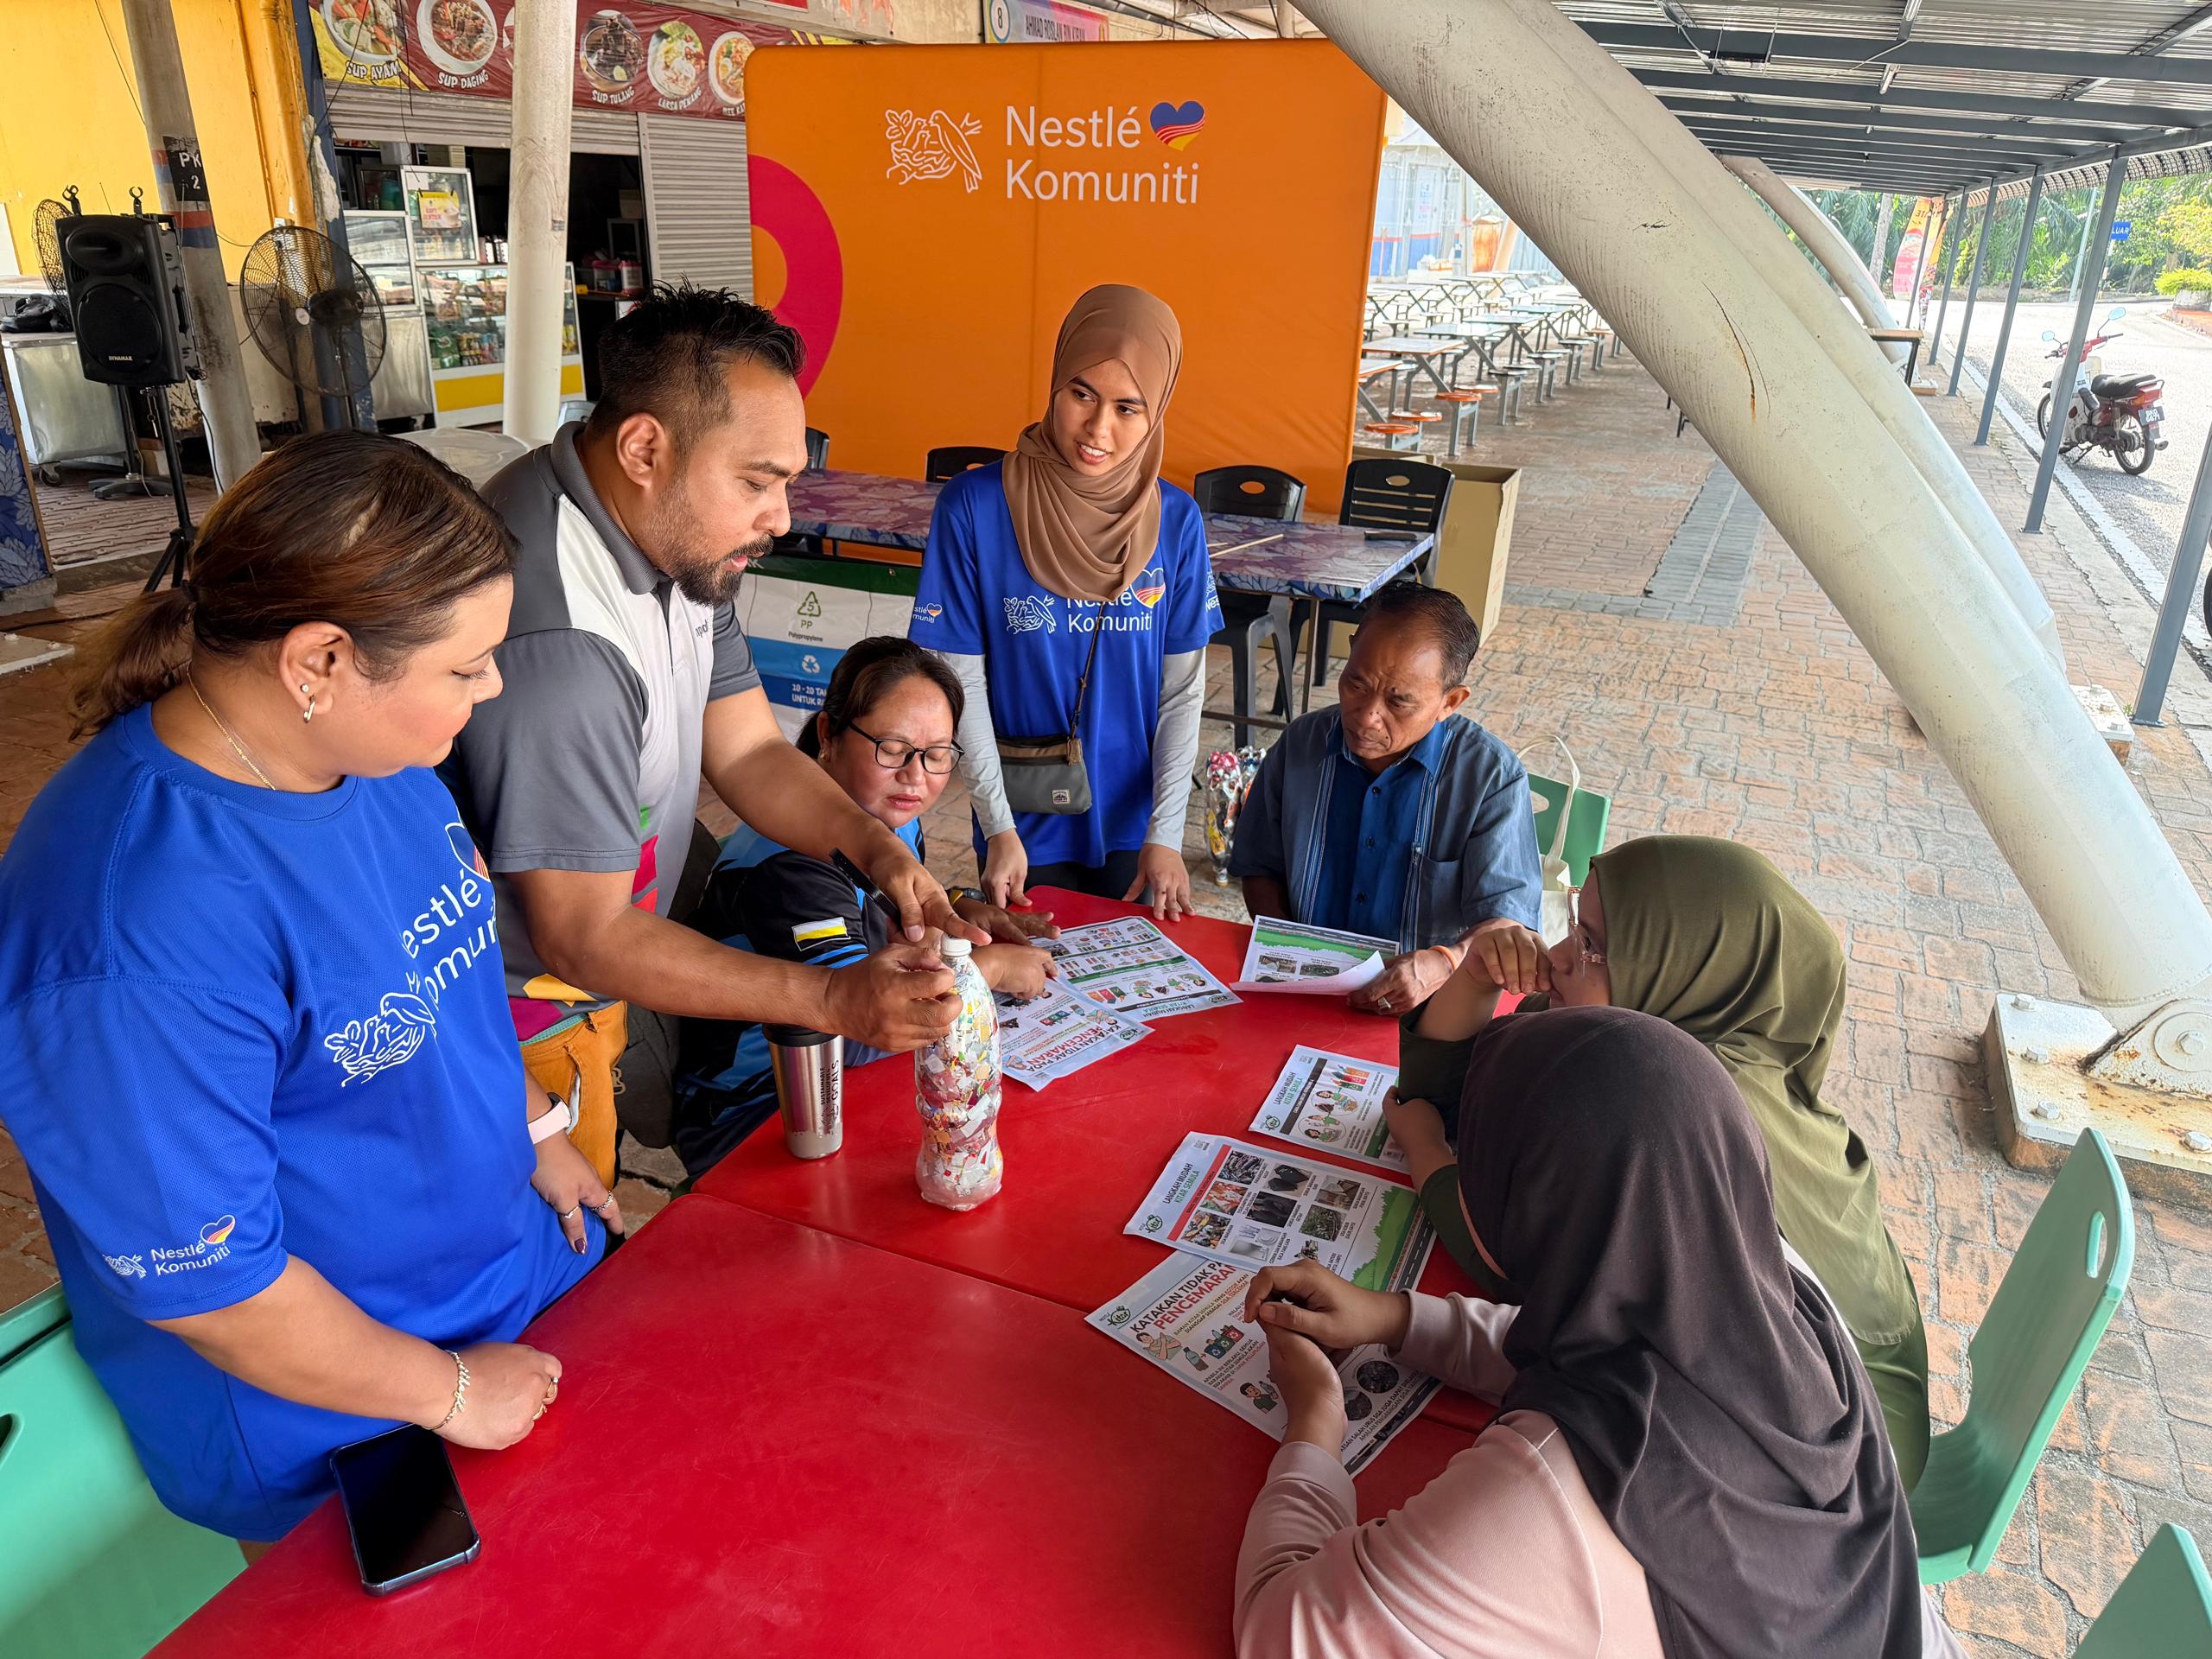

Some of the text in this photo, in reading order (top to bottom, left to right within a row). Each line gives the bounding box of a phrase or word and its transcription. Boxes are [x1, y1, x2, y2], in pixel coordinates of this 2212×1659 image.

[997, 7, 1002, 29] 8
[1026, 14, 1043, 37] AHMAD
[346, 59, 401, 81] SUP AYAM
[437, 69, 490, 89] SUP DAGING
[592, 86, 636, 105] SUP TULANG
[658, 98, 678, 111] LAKSA
[1006, 104, 1141, 149] Nestlé
[179, 152, 202, 168] PK
[191, 175, 201, 189] 2
[1006, 158, 1200, 205] Komuniti
[806, 601, 815, 612] 5
[800, 619, 813, 630] PP
[912, 613, 935, 624] muniti
[1068, 611, 1153, 632] Komuniti
[788, 630, 823, 643] Polypropylene
[791, 694, 817, 706] UNTUK
[401, 868, 481, 958] estlé
[1028, 1025, 1099, 1064] PENCEMARAN
[1079, 1025, 1120, 1048] KATAKAN
[1053, 1046, 1079, 1059] TIDAK
[1027, 1058, 1053, 1072] PADA
[1162, 1163, 1192, 1204] LANGKAH MUDAH
[1174, 1170, 1199, 1203] KITAR SEMULA
[150, 1239, 206, 1262] Nestlé
[155, 1243, 231, 1277] Komuniti
[1131, 1291, 1182, 1332] KATAKAN
[1179, 1268, 1210, 1293] TIDAK
[1188, 1313, 1198, 1323] KITAR
[1214, 1293, 1225, 1302] YANG
[1236, 1274, 1248, 1283] AKAN
[1351, 1425, 1365, 1440] SALAH
